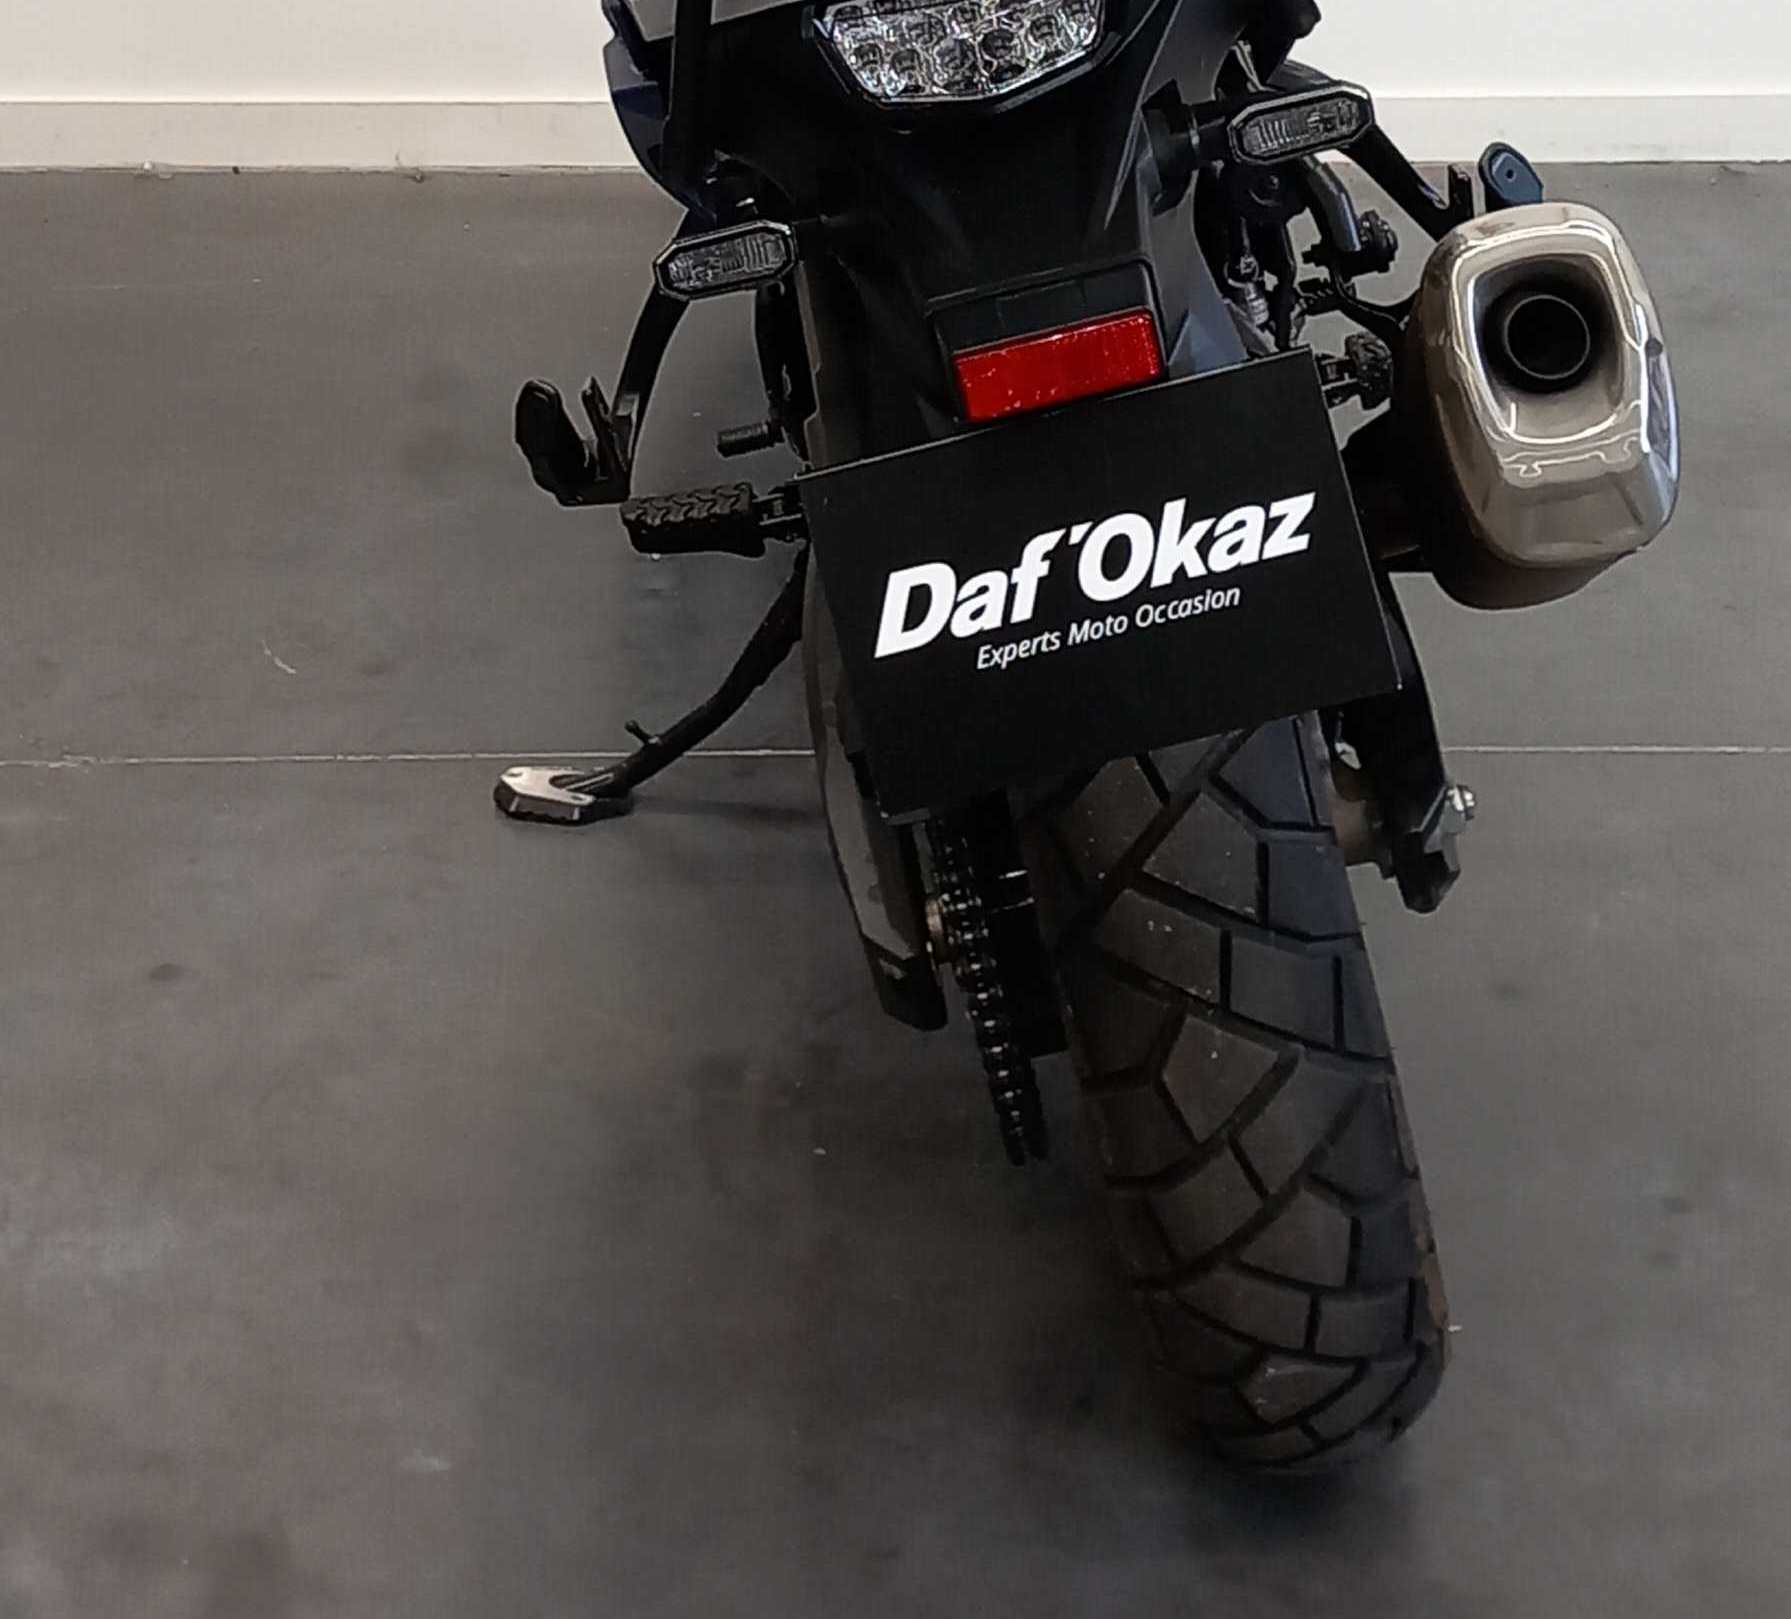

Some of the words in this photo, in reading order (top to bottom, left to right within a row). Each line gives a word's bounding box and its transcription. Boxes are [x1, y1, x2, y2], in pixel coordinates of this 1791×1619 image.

[976, 630, 1061, 670] Experts
[1067, 615, 1128, 645] Moto
[1135, 587, 1241, 628] Occasion
